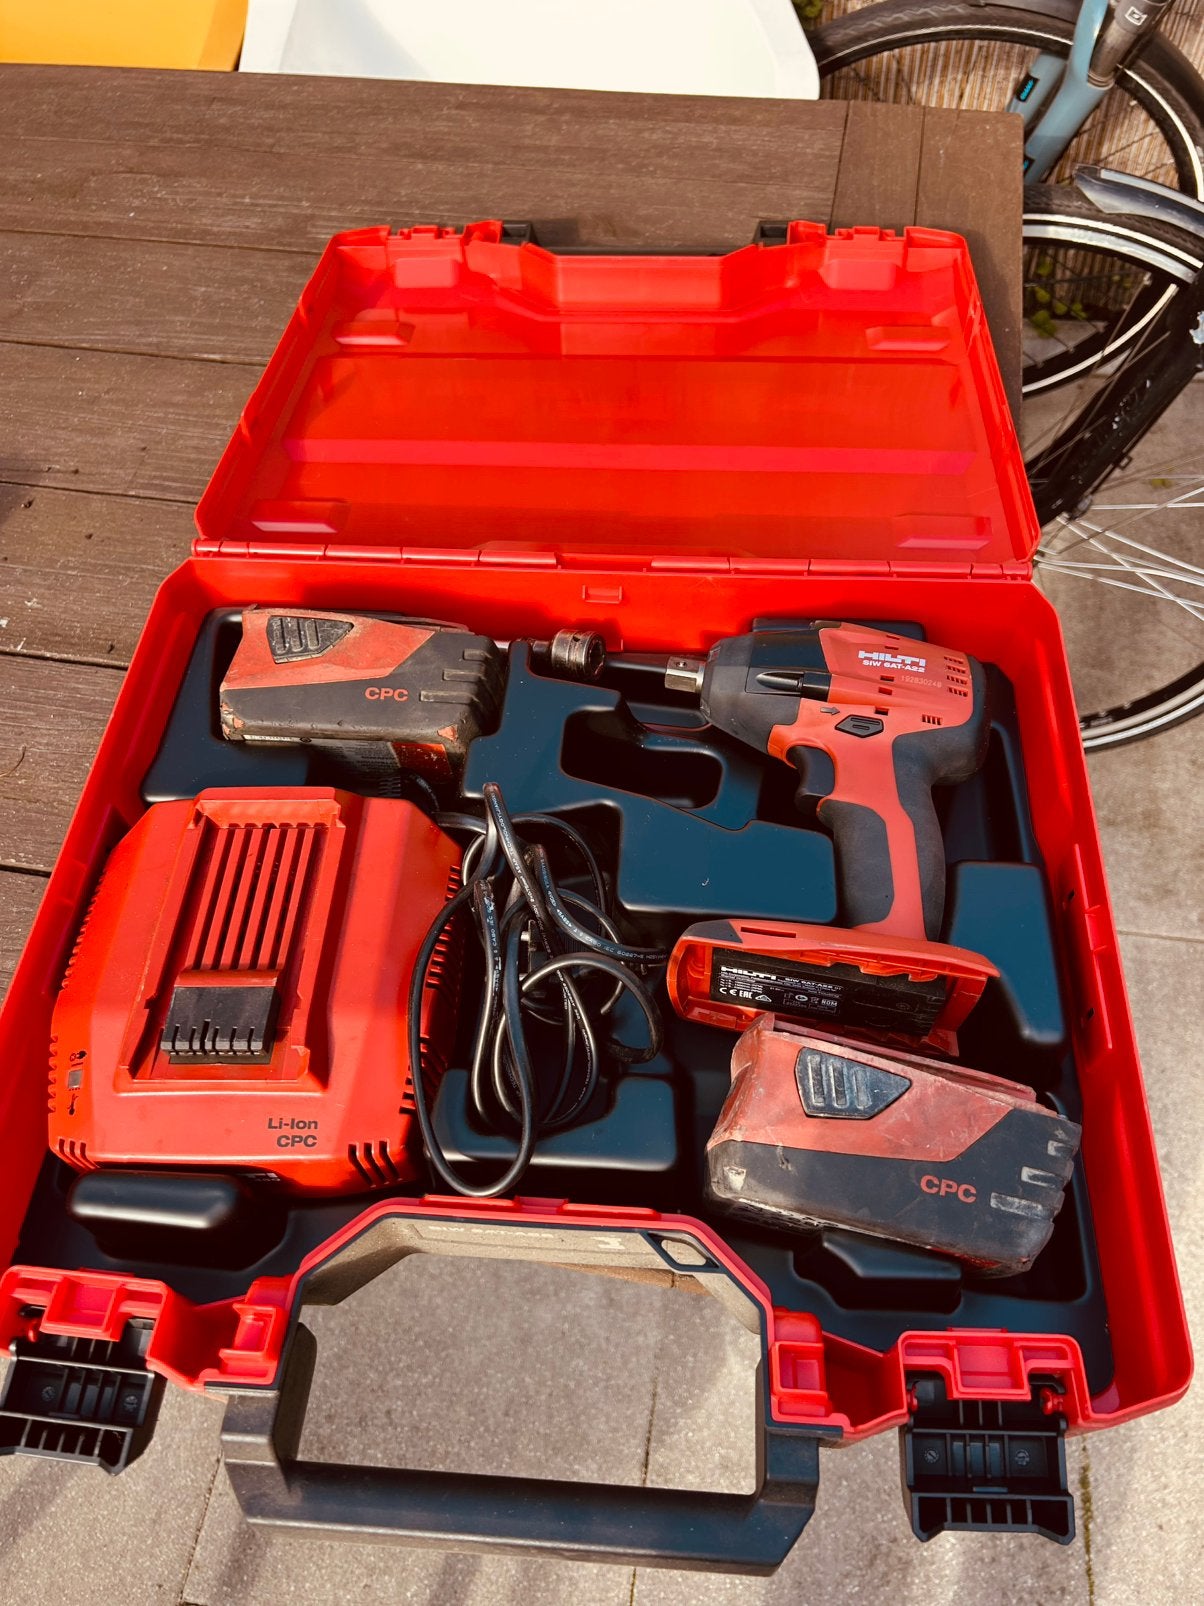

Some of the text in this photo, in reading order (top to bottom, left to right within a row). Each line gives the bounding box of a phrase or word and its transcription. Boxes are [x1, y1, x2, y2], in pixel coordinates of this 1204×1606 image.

[858, 650, 926, 666] HILTI
[884, 663, 925, 673] 6AT-A22
[365, 687, 408, 701] CPC
[721, 966, 776, 980] HILTI
[267, 1117, 318, 1129] Li-Ion
[277, 1135, 318, 1147] CPC
[920, 1174, 977, 1203] CPC
